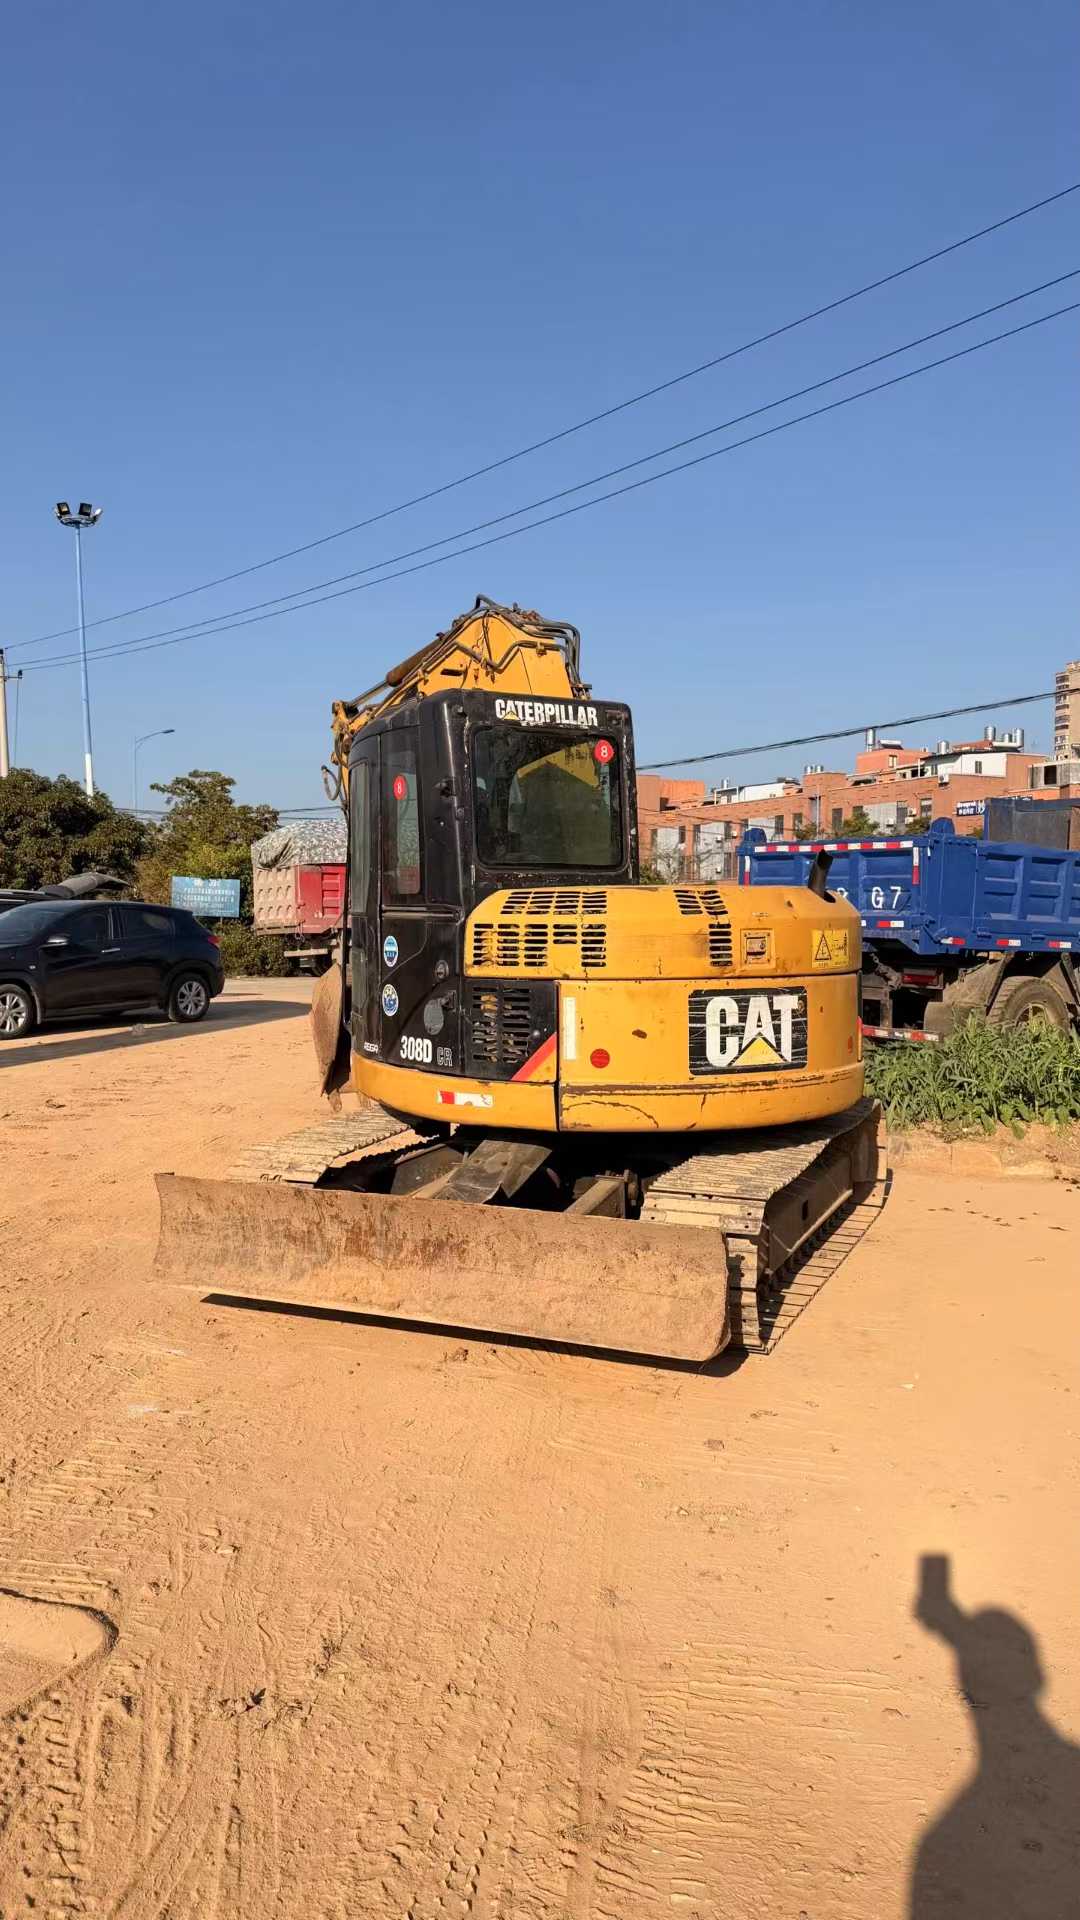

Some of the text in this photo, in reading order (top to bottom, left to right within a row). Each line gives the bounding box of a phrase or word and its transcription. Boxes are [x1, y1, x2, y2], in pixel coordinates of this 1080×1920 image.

[495, 699, 598, 727] CATERPILLAR
[600, 746, 608, 757] 8
[706, 995, 799, 1067] CAT
[400, 1035, 453, 1067] 308D CR
